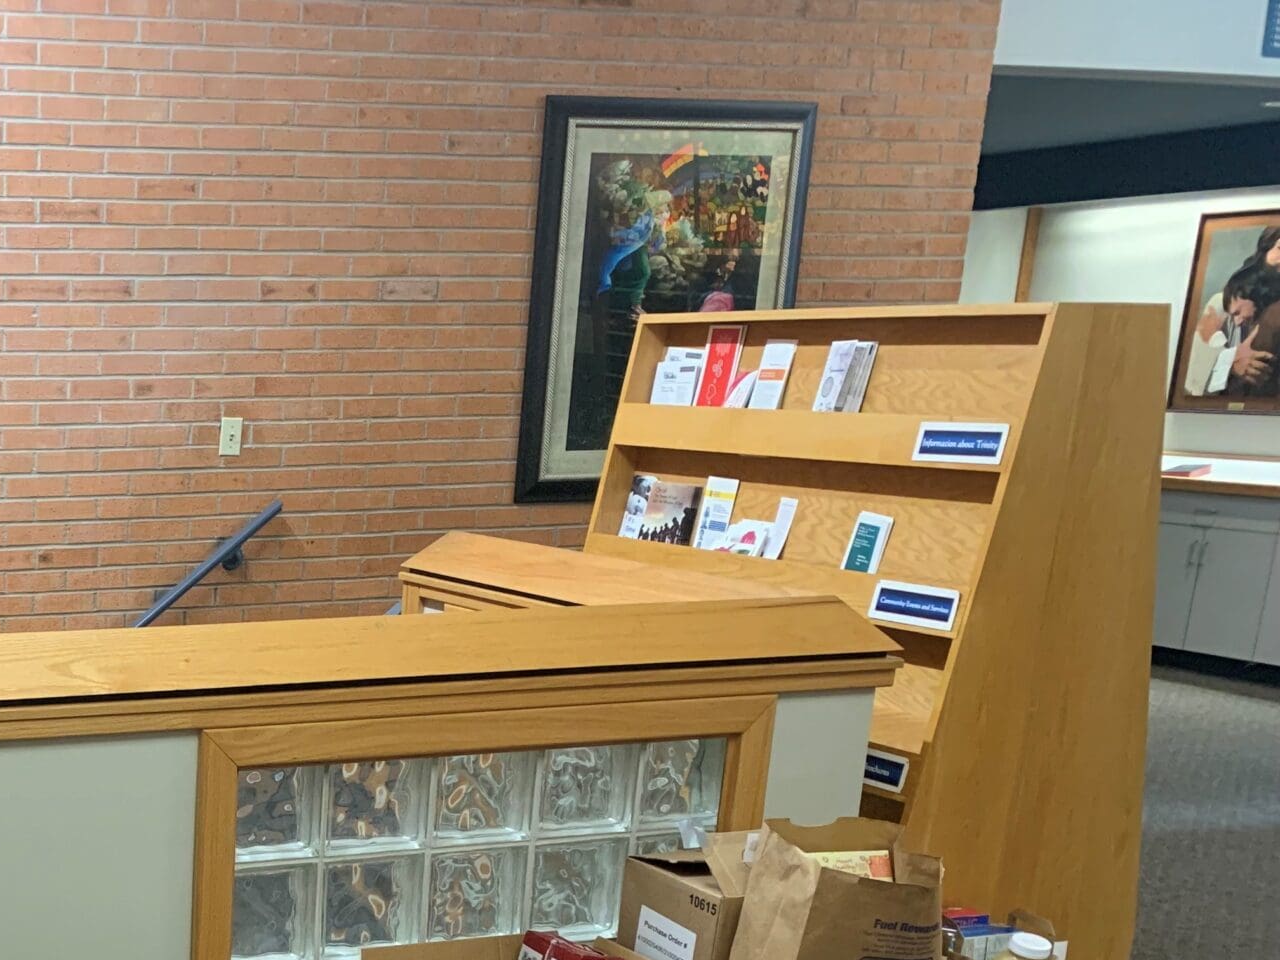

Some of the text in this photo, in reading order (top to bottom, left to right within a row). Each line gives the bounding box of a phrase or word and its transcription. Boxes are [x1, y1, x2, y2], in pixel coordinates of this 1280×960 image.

[922, 438, 957, 450] Information
[976, 439, 999, 451] Trinity
[688, 894, 718, 917] 10615
[873, 918, 897, 930] Fuel
[643, 919, 668, 939] Purchase
[667, 933, 684, 949] Order
